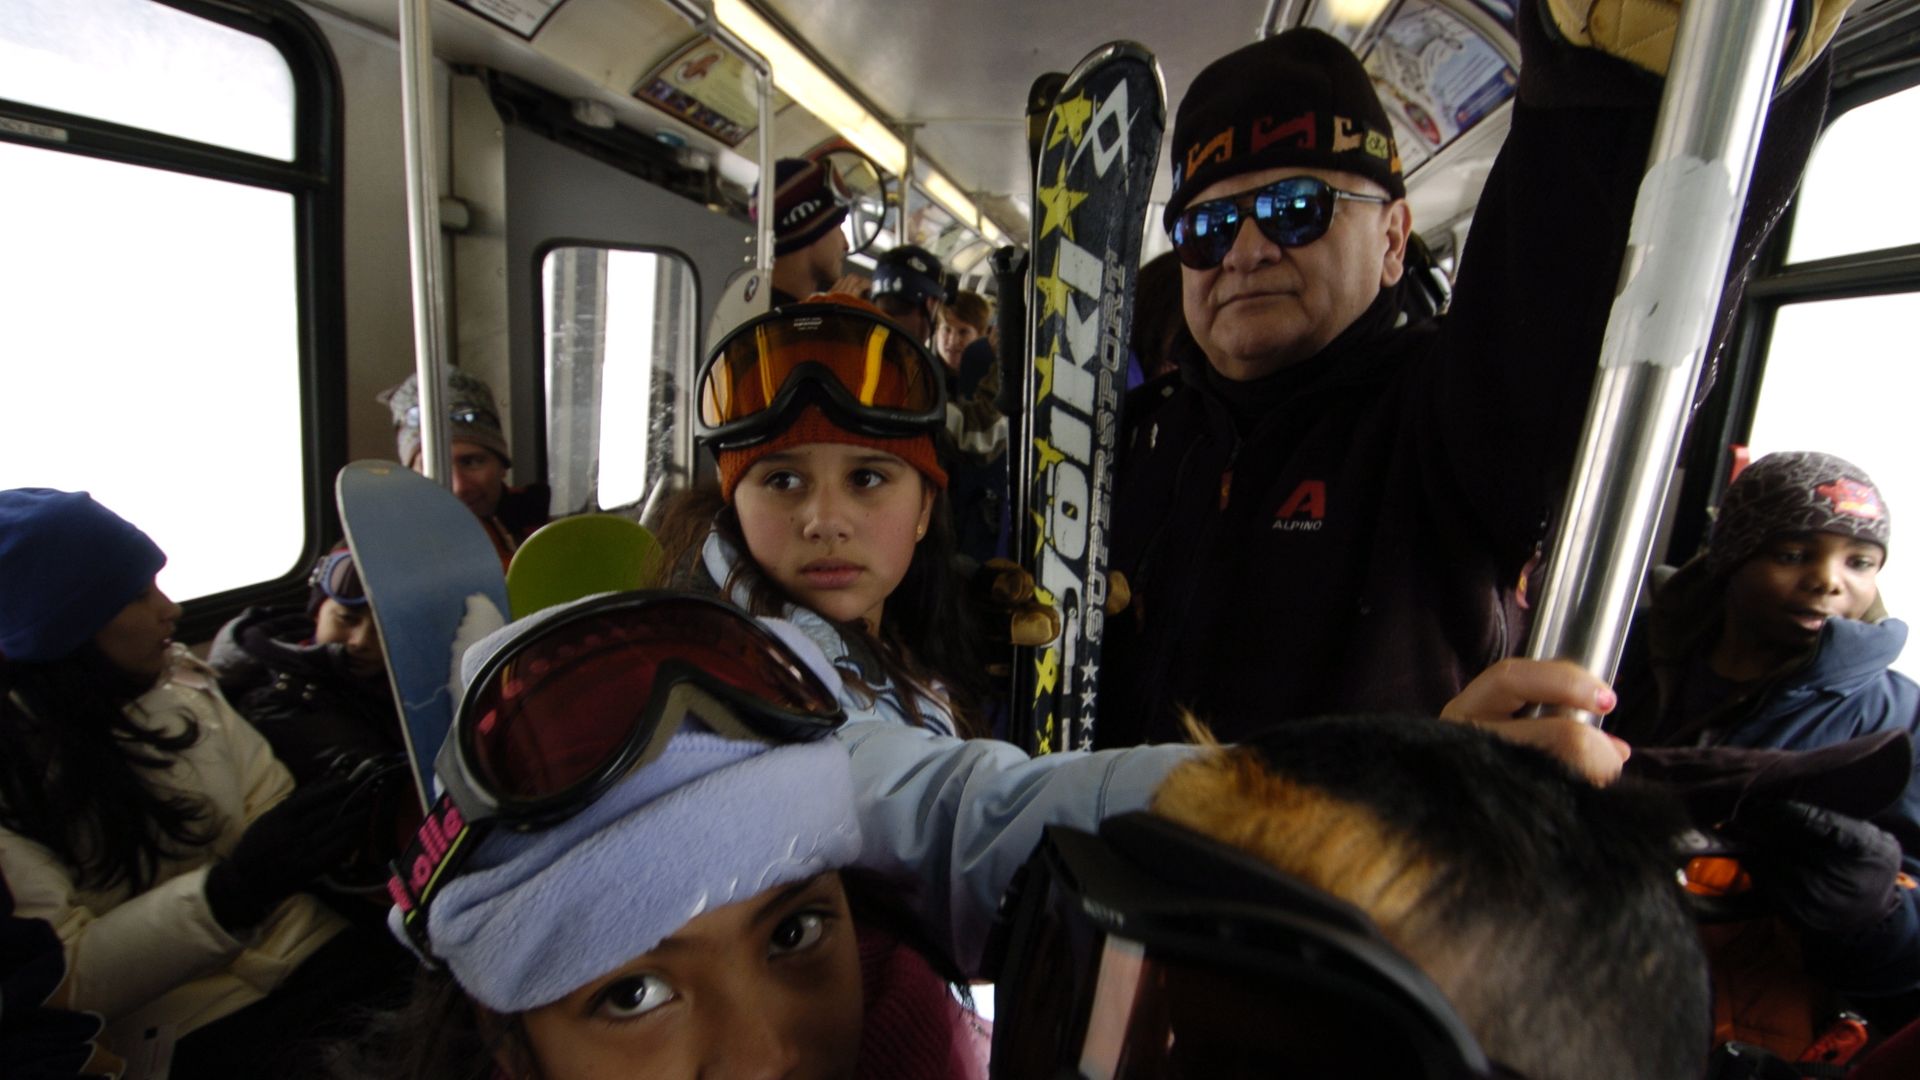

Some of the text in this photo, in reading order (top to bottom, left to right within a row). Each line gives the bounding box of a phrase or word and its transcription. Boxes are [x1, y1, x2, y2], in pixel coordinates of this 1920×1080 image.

[1084, 246, 1126, 646] SUPERSPORT
[1274, 480, 1326, 519] A
[1272, 520, 1323, 531] ALPINO
